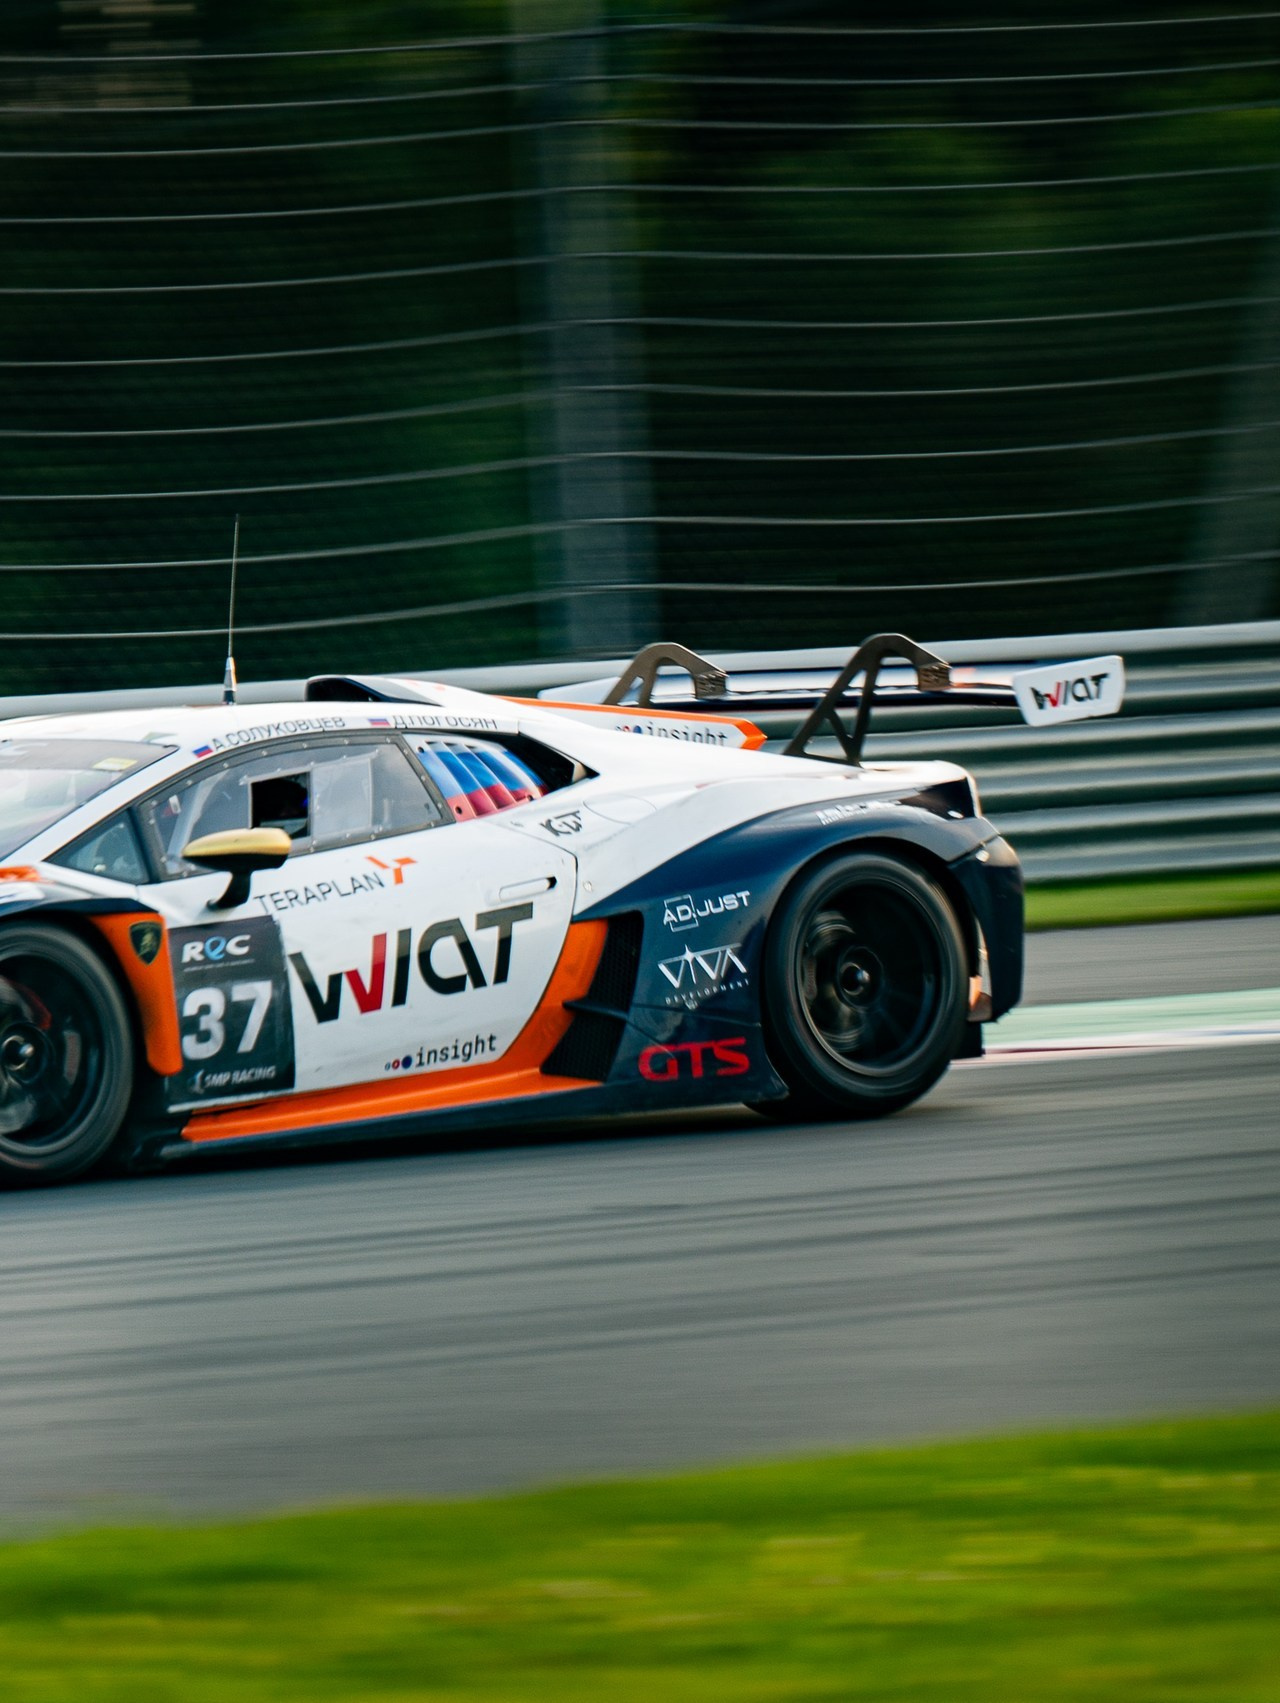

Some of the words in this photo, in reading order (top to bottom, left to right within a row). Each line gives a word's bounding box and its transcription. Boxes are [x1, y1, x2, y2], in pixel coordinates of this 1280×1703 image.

[252, 871, 386, 915] TERAPLAN
[288, 902, 534, 1025] WIAT
[181, 979, 273, 1061] 37
[415, 1033, 497, 1068] insight
[637, 1037, 751, 1083] GTS
